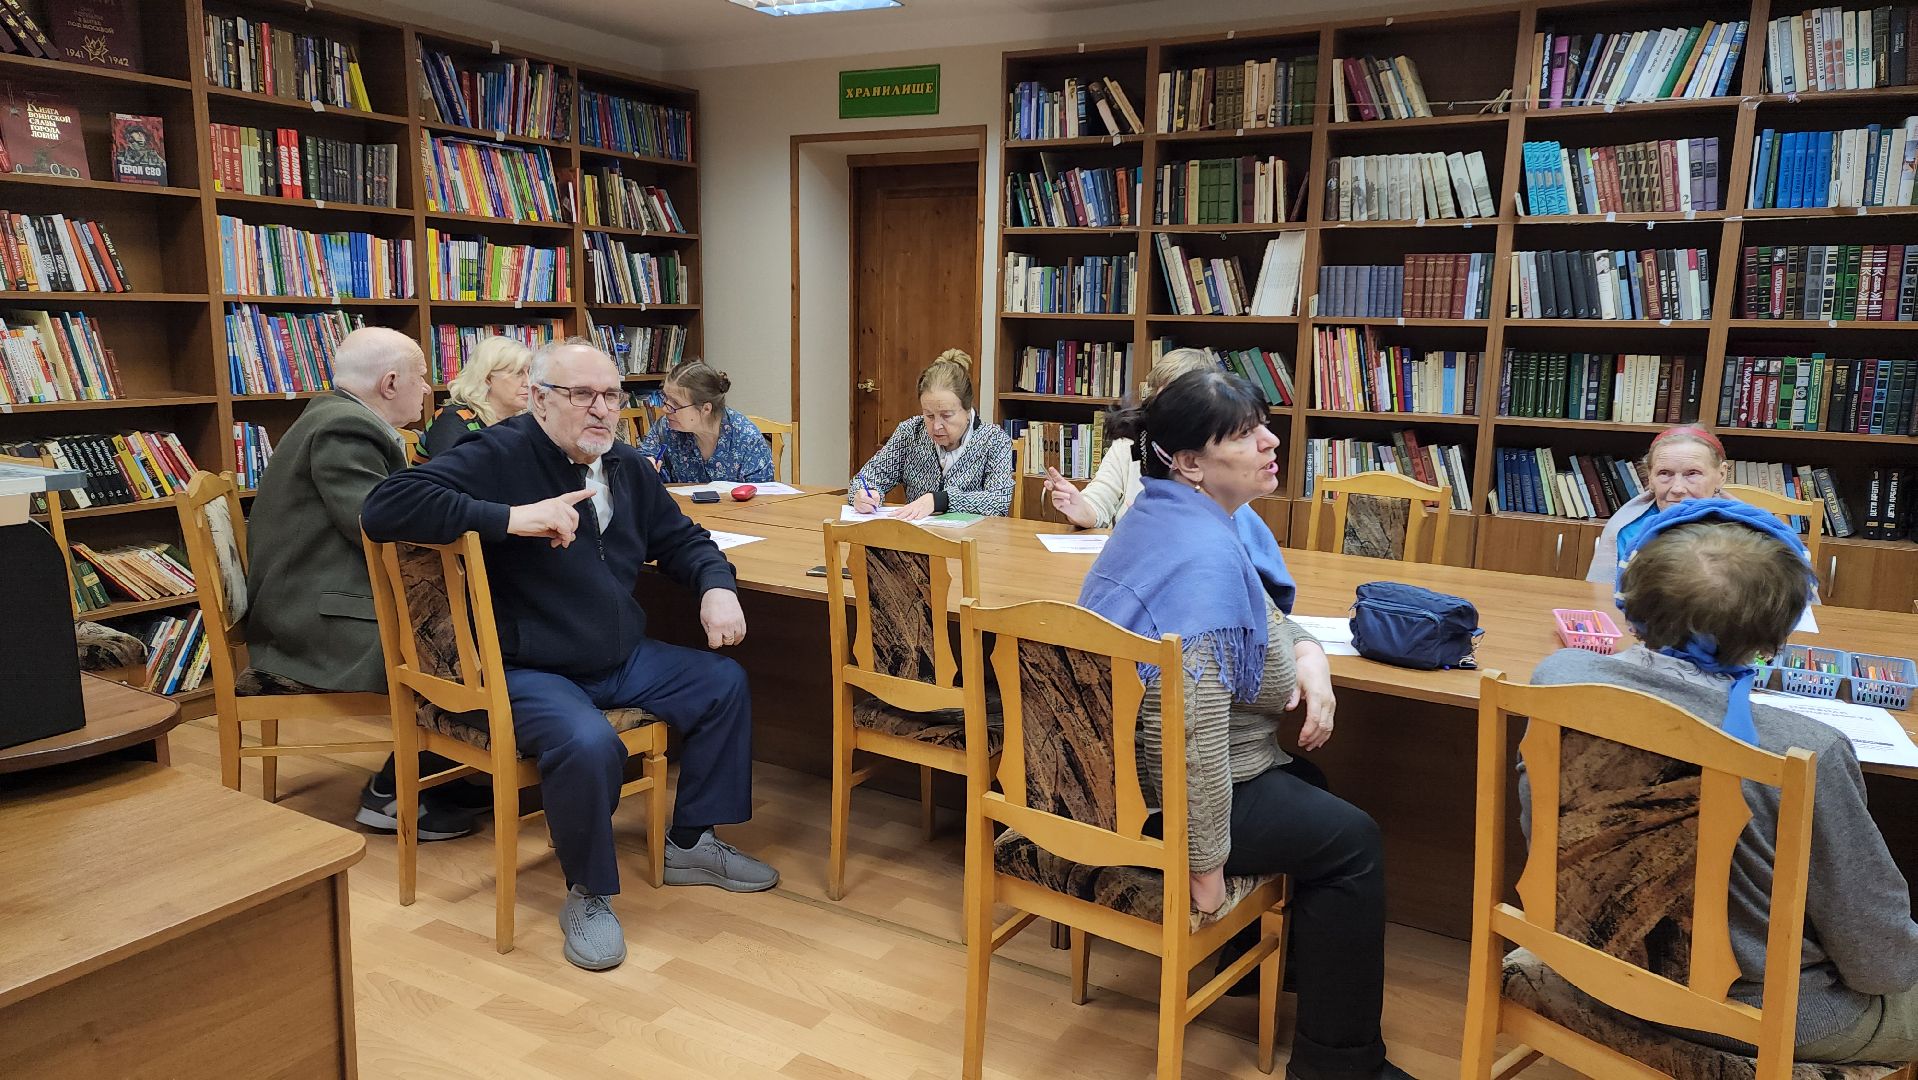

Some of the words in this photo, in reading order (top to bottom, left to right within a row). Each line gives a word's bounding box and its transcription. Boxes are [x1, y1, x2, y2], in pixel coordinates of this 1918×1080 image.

[65, 47, 84, 59] 1941
[108, 55, 129, 67] 1942
[846, 82, 934, 99] ХРАНИЛИЩЕ
[28, 111, 71, 124] ВОИНСКОЙ
[29, 117, 57, 127] СЛАВЫ
[30, 124, 61, 134] ГОРОДА
[119, 164, 144, 175] ГЕРОИ
[145, 166, 162, 177] СВО
[279, 145, 292, 186] ОБЛОМОВ
[290, 146, 302, 187] ОБЛОМОВ
[1870, 480, 1880, 501] АРБАТА
[1889, 481, 1899, 503] АРБАТА
[1869, 500, 1878, 517] ДЕТИ
[1887, 502, 1896, 518] ДЕТИ
